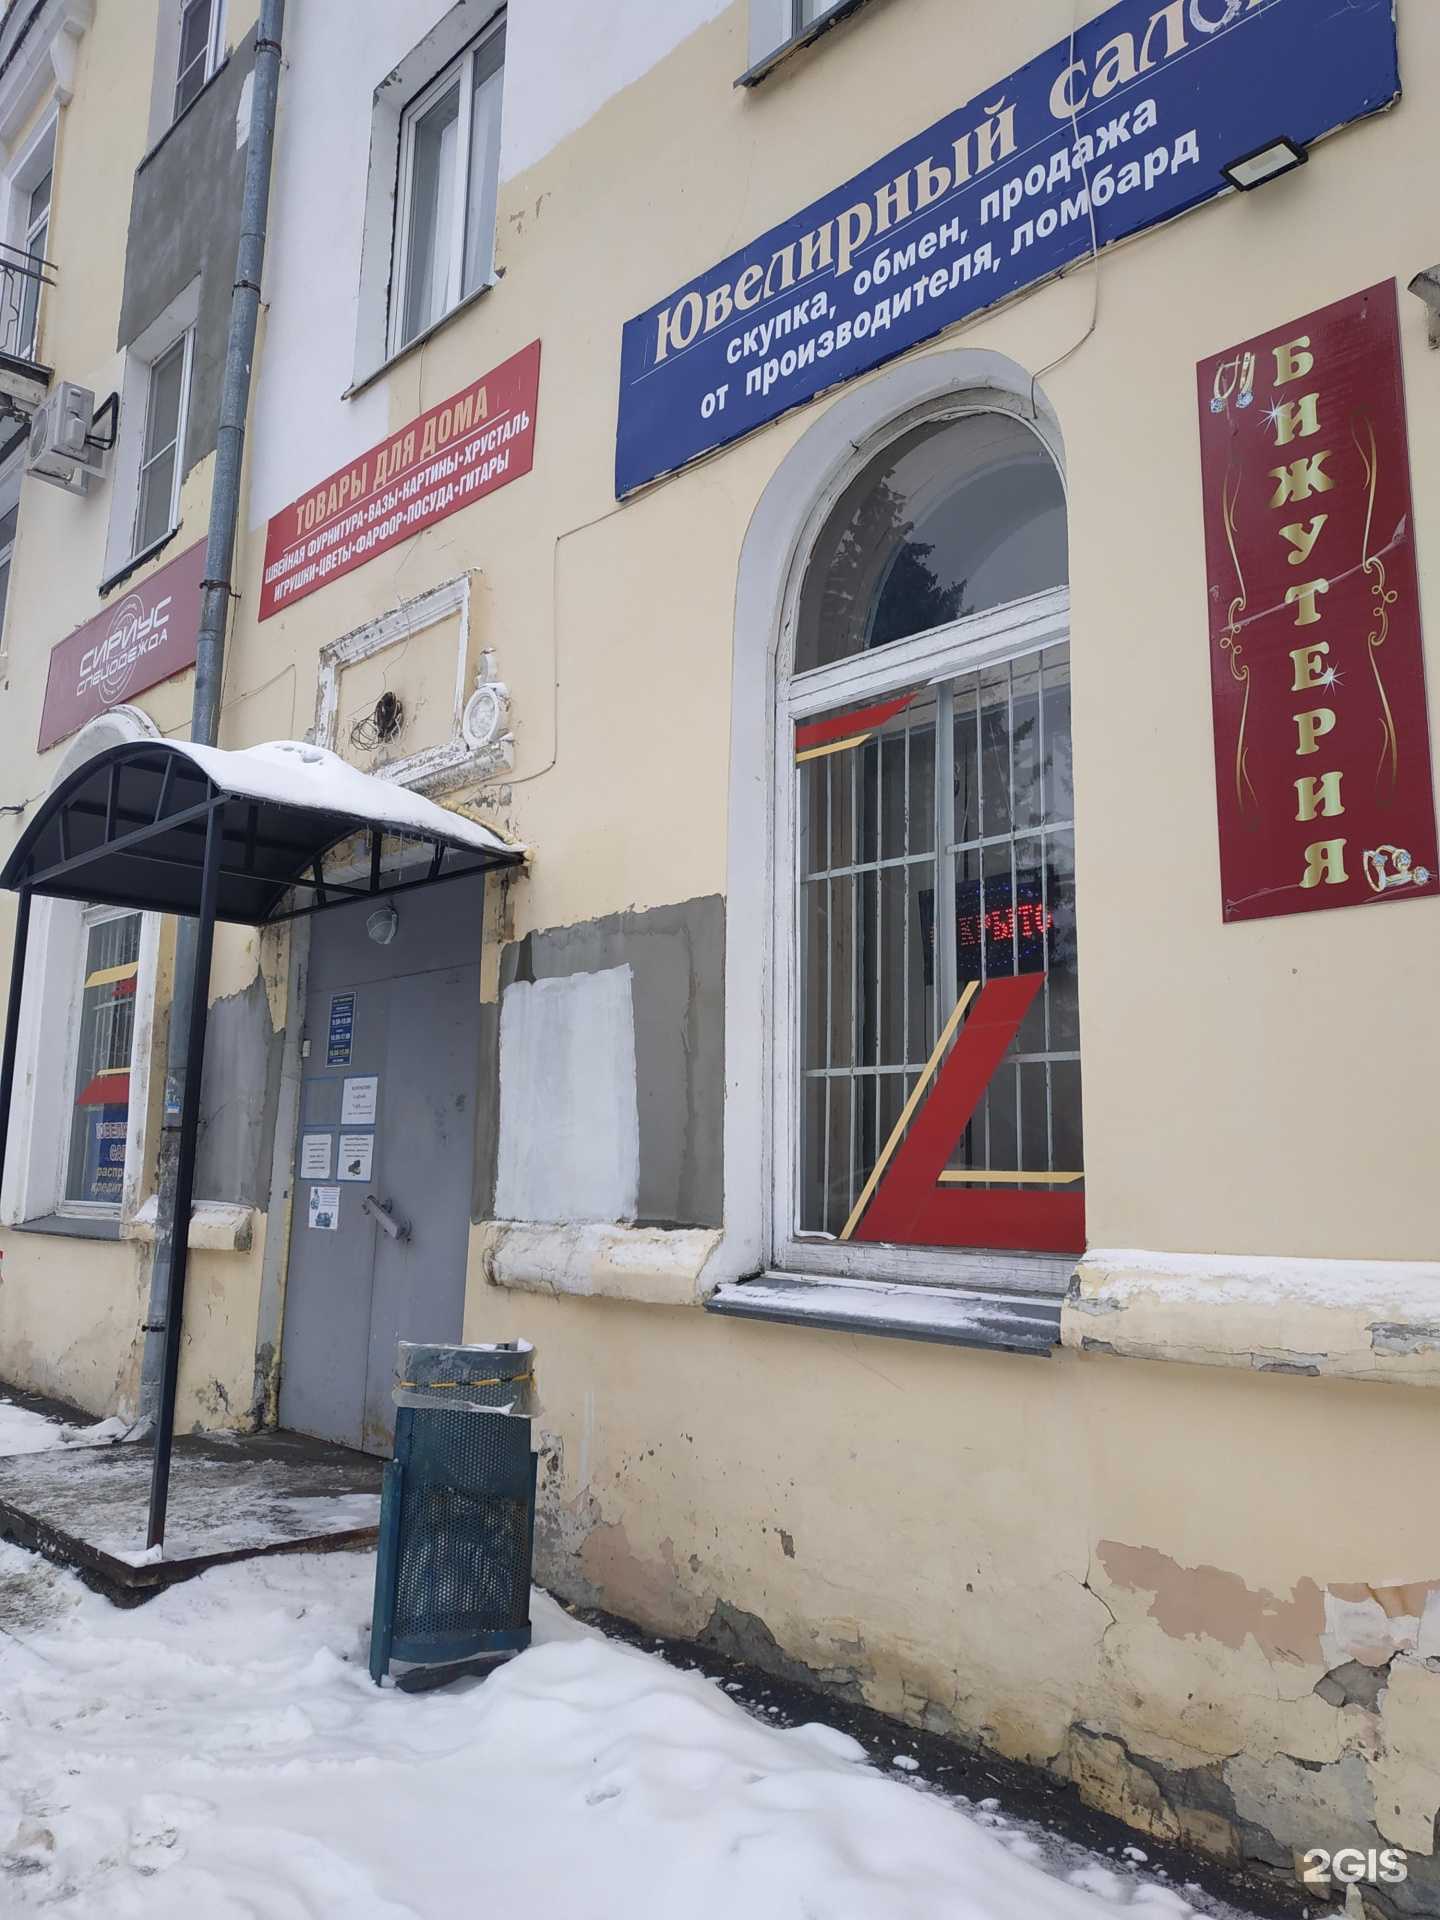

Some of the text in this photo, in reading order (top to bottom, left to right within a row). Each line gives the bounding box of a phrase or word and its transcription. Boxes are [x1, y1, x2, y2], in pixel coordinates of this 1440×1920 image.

[654, 0, 1264, 365] Ювелирный сало
[700, 129, 1200, 419] от производителя, ломбард
[726, 98, 1158, 364] скупка, обмен, продажа
[265, 547, 306, 584] ШВЕЙНАЯ
[307, 514, 364, 560] ФУРНИТУРА
[296, 386, 488, 535] ТОВАРЫ ДЛЯ ДОМА
[76, 629, 168, 696] СПЕЦОДЕЖДА
[79, 596, 172, 677] СИРИУС
[1266, 335, 1350, 888] БИЖУТЕРИЯ
